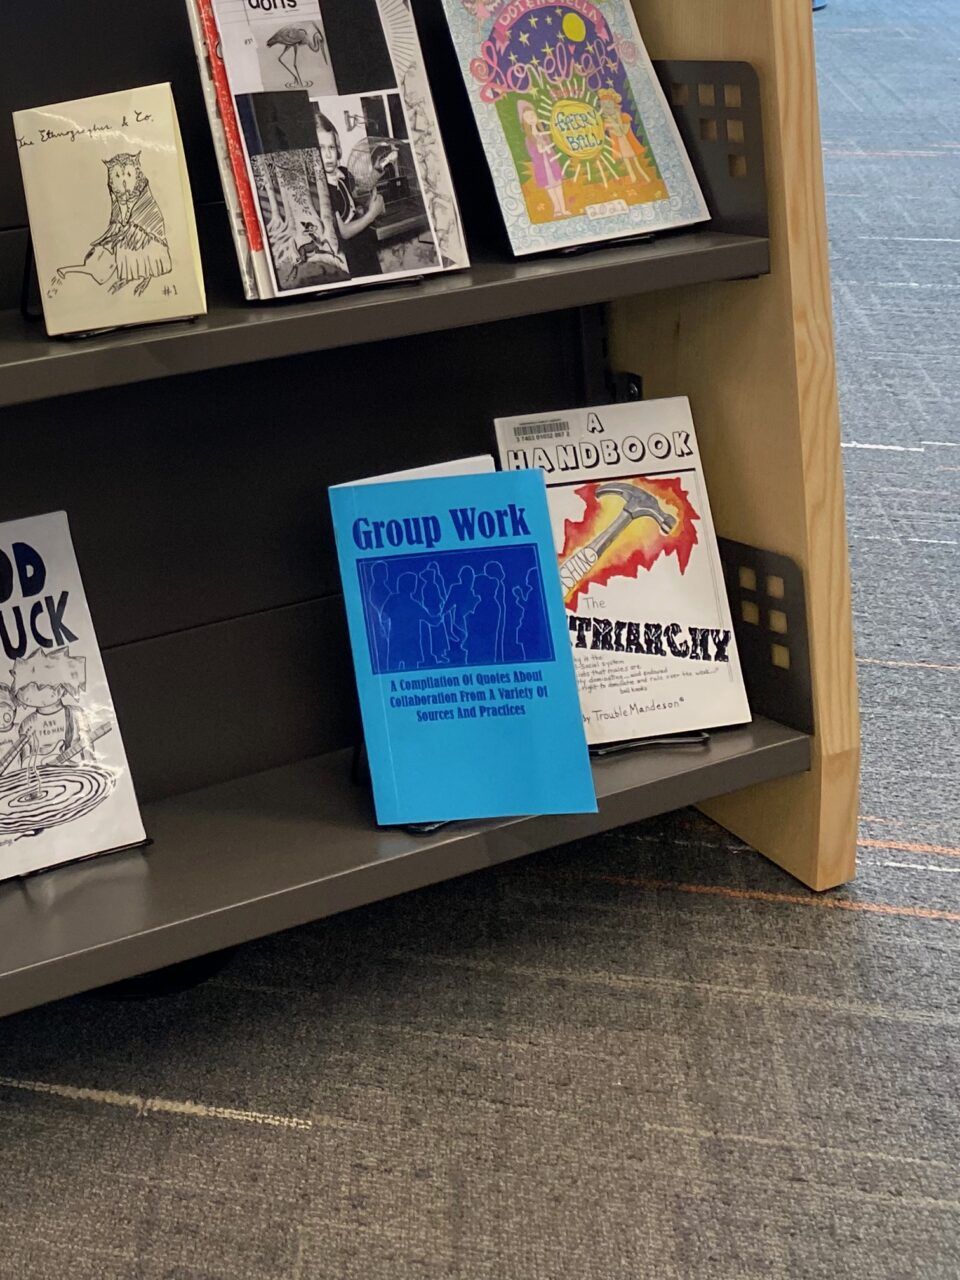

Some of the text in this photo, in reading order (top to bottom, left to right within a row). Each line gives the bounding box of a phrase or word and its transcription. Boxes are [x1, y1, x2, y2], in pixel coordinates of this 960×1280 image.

[587, 412, 604, 433] A
[507, 431, 694, 472] HANDBOOK
[352, 504, 531, 550] Group Work
[583, 597, 606, 609] The
[569, 616, 732, 663] TRIARCHY
[390, 670, 543, 692] A Compilation Of Quotes About
[390, 685, 548, 708] Collaboration From A Variety Of
[416, 704, 526, 722] Sources And Practices
